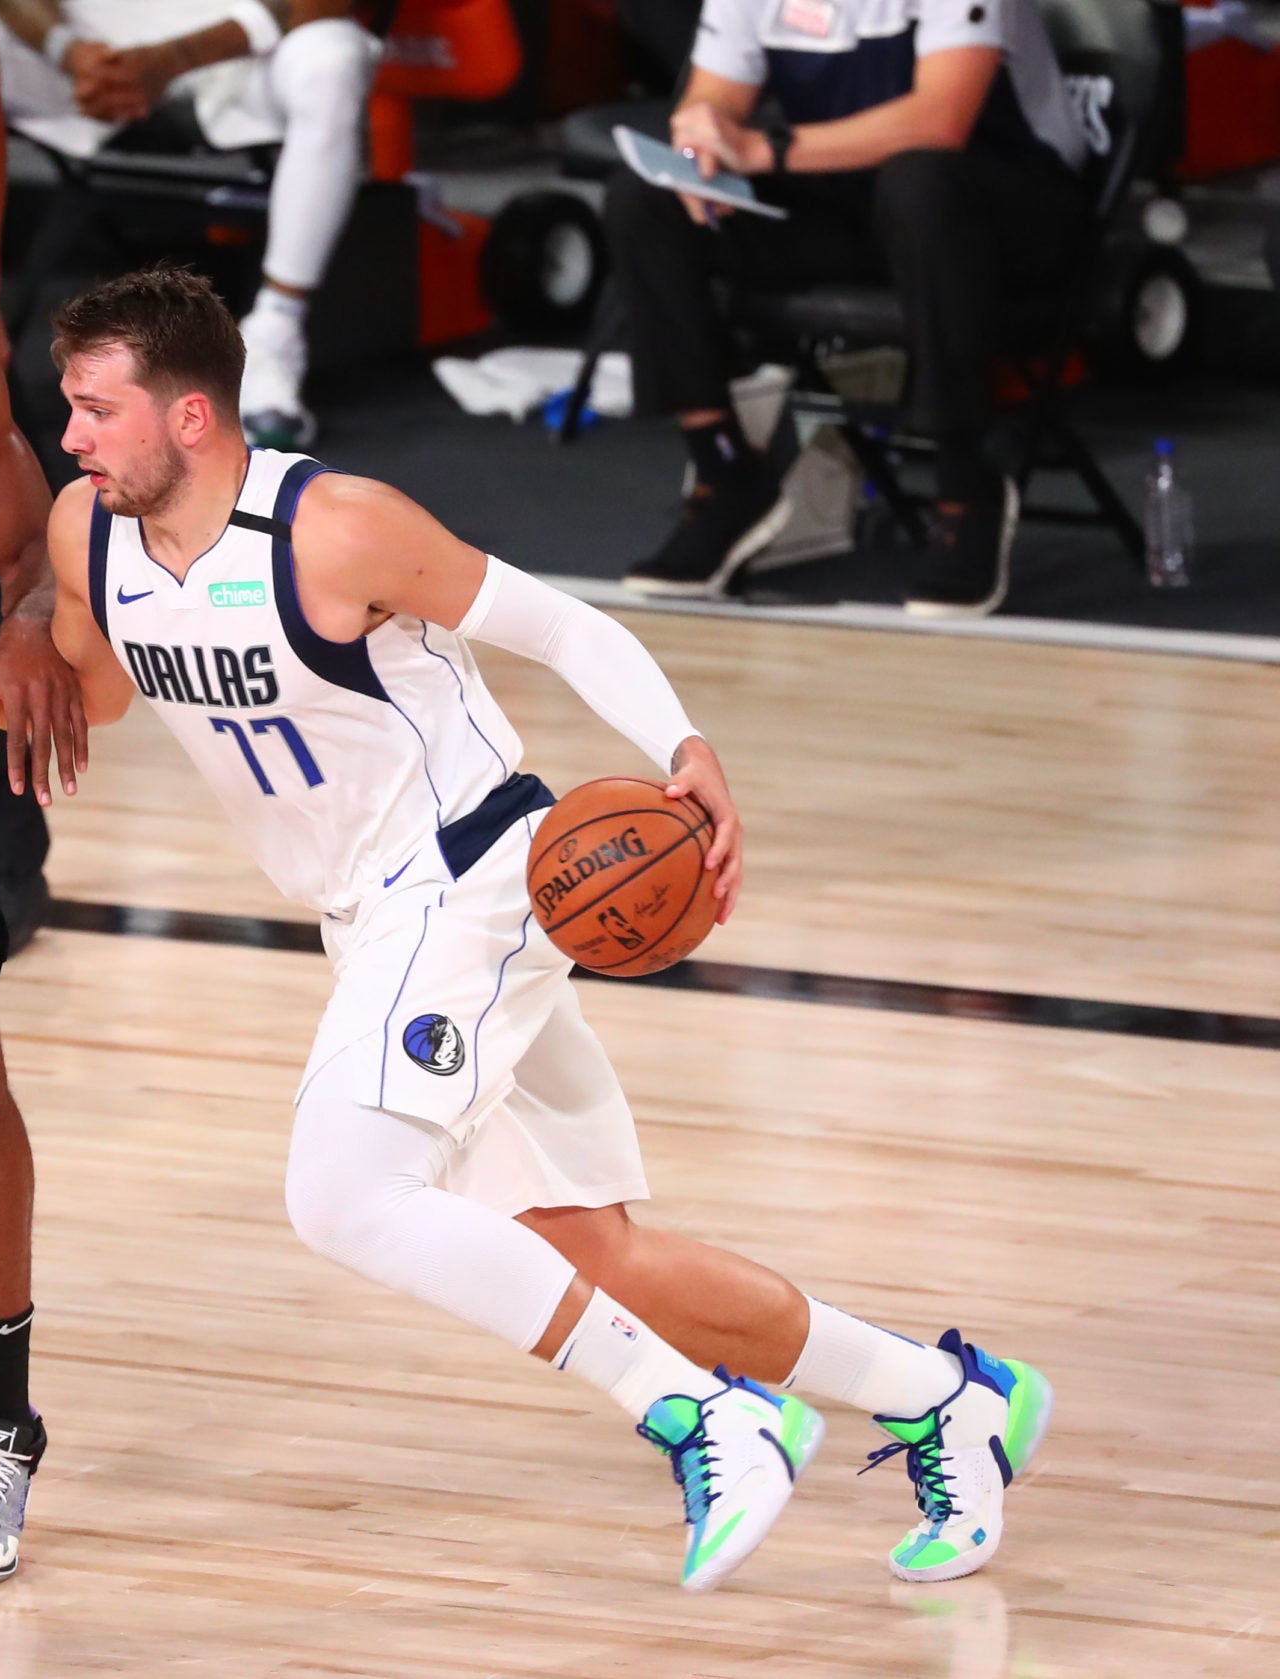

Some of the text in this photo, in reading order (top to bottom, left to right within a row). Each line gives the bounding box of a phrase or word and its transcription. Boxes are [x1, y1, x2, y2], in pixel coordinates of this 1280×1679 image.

[211, 584, 266, 606] chime
[122, 640, 280, 708] DALLAS
[207, 715, 327, 797] 77
[534, 827, 648, 921] SPALDING
